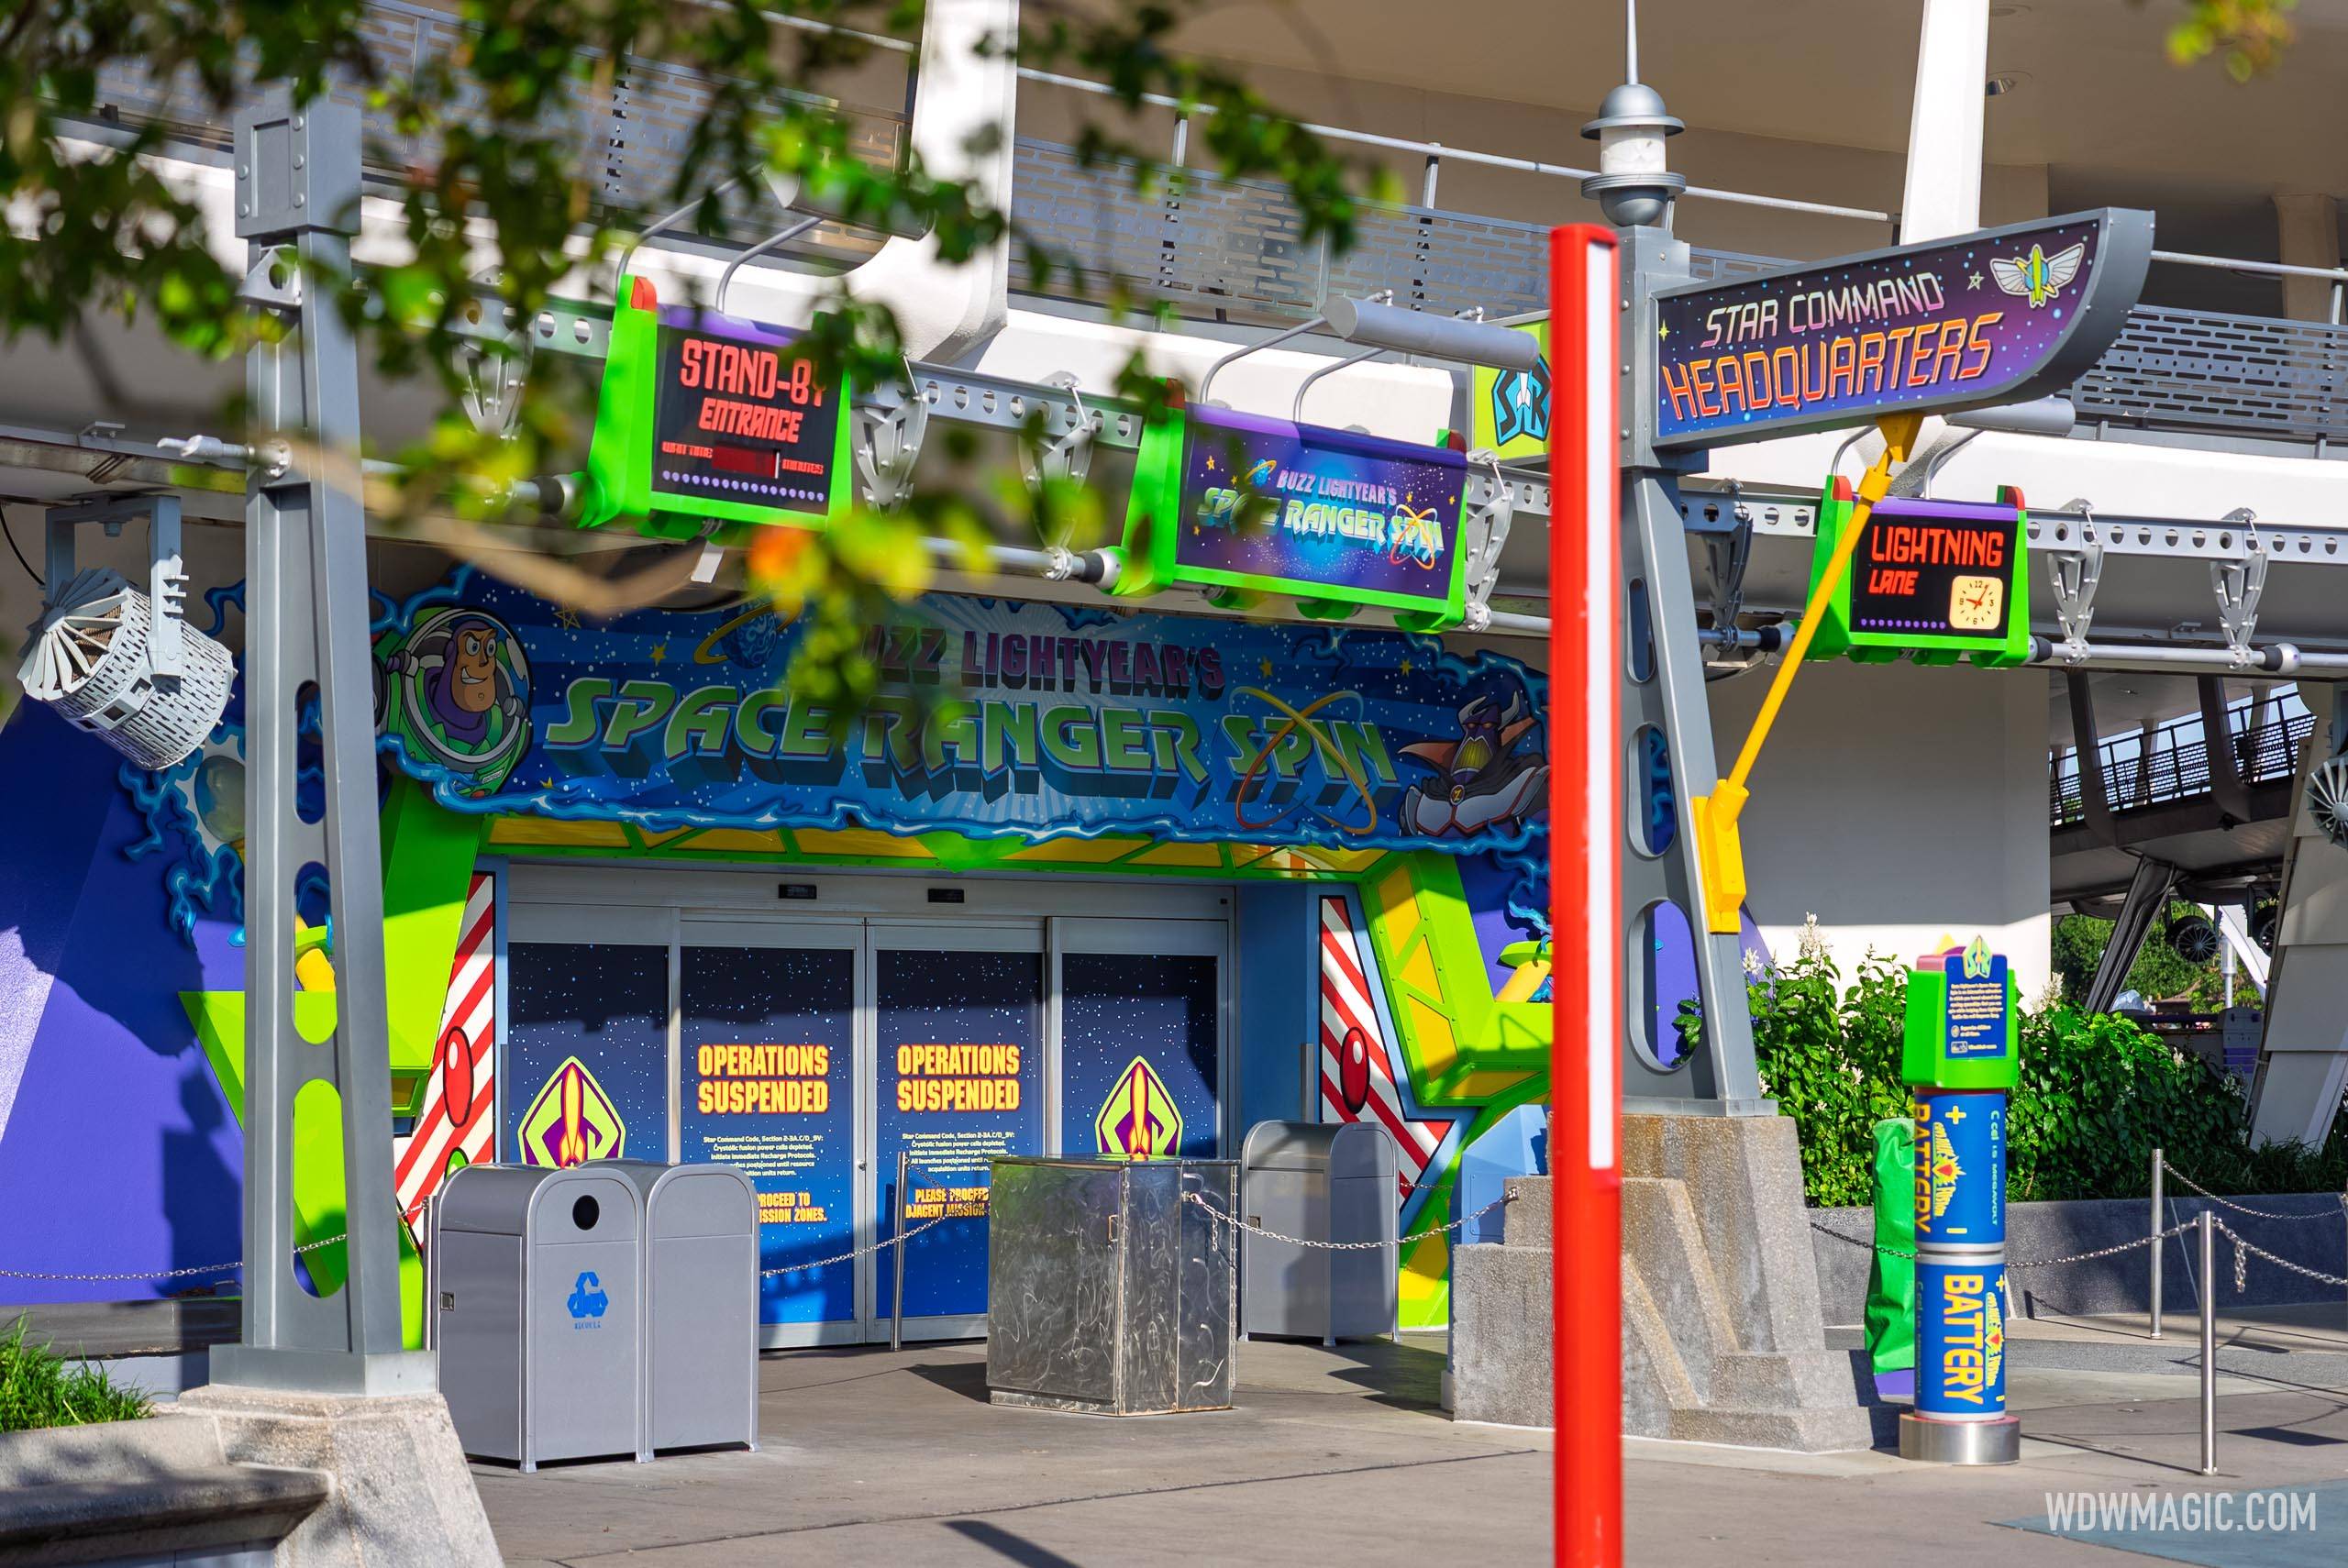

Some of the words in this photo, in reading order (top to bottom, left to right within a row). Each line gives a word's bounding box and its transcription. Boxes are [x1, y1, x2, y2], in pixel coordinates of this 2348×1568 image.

[1700, 299, 1778, 348] STAR
[1788, 271, 1944, 334] COMMAND
[1662, 311, 2003, 421] HEADQUARTERS
[698, 397, 803, 443] ENTRANCE
[781, 458, 824, 475] MINUTES
[1277, 469, 1316, 493] BUZZ
[1318, 478, 1398, 505] LIGHTYEAR'S
[1284, 499, 1386, 547] RANGER
[1389, 515, 1445, 554] SPIN
[1871, 525, 2004, 567] LIGHTNING
[1868, 569, 1920, 595] LANE
[962, 630, 1226, 701] LIGHTYEAR'S
[543, 677, 839, 784] SPACE
[859, 695, 1212, 798] RANGER
[1221, 713, 1402, 796] SPIN
[697, 1043, 829, 1077] OPERATIONS
[896, 1043, 1020, 1077] OPERATIONS
[697, 1079, 829, 1115] SUSPENDED
[896, 1077, 1020, 1112] SUSPENDED
[1915, 1104, 1932, 1233] BATTERY
[798, 1192, 811, 1207] TO
[905, 1203, 944, 1219] DJACENT
[915, 1188, 947, 1203] PLEASE
[759, 1209, 792, 1223] ISSION
[794, 1208, 827, 1223] ZONES.
[1944, 1275, 1984, 1405] BATTERY
